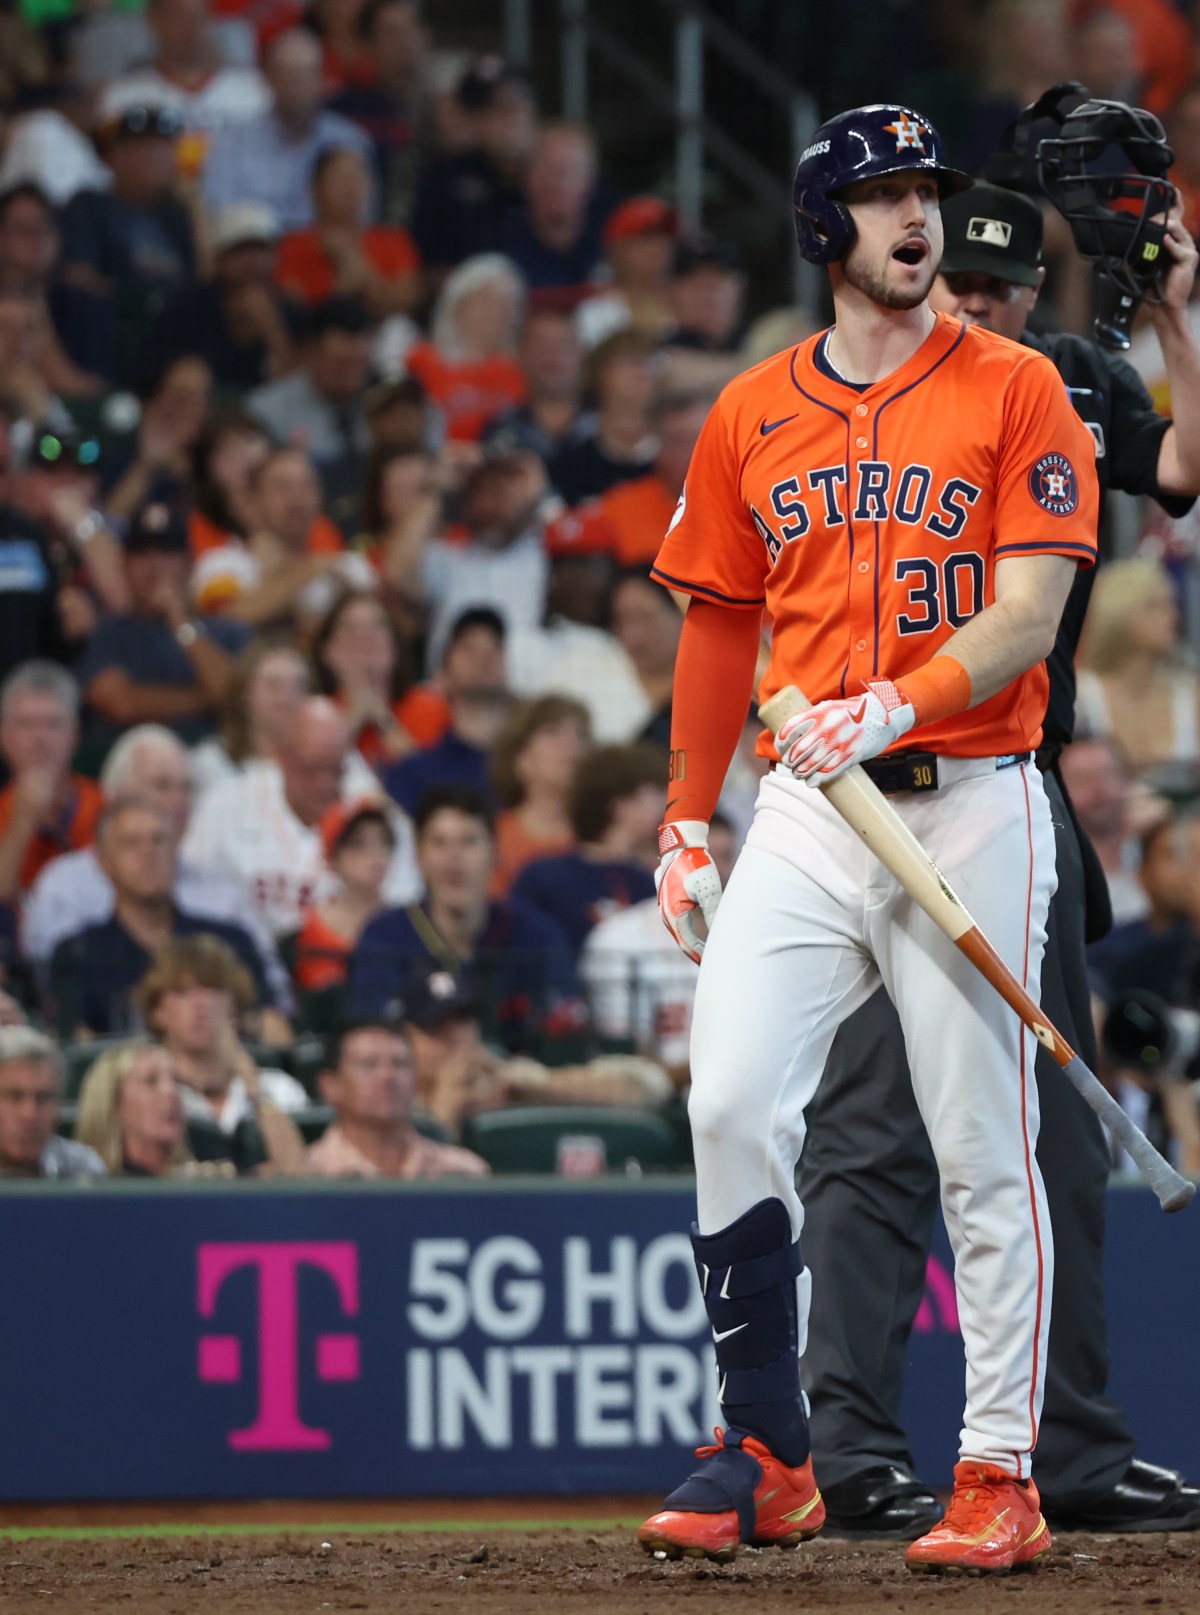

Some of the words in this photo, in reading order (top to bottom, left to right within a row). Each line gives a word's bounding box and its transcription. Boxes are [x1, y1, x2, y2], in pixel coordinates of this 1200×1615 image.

[891, 121, 925, 149] H
[1036, 456, 1072, 475] HOUSTON
[1046, 474, 1066, 497] H
[751, 460, 982, 568] ASTROS
[1040, 497, 1074, 513] ASTROS
[895, 551, 984, 637] 30
[913, 765, 932, 786] 30
[406, 1234, 547, 1341] 5G
[406, 1344, 730, 1449] INTER
